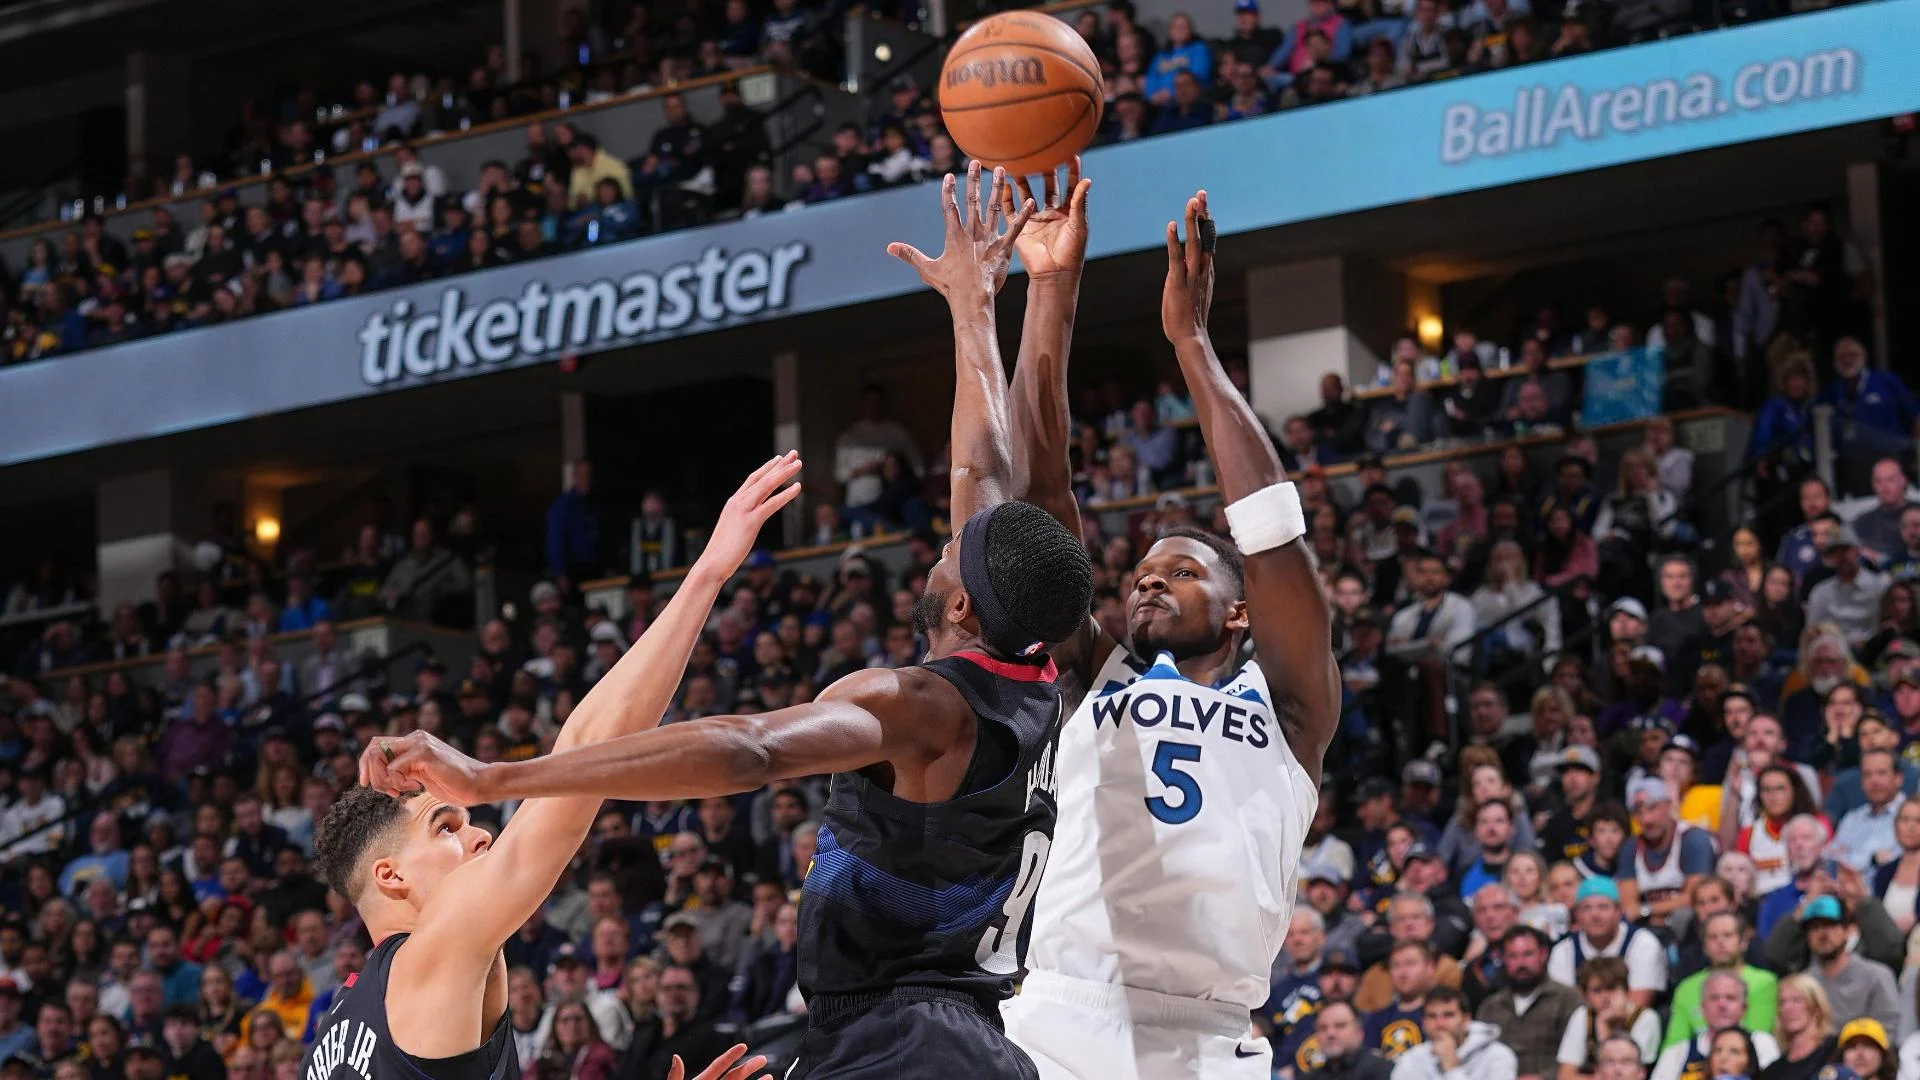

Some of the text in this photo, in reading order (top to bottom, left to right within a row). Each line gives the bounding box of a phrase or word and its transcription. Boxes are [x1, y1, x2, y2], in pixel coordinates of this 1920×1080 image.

[1440, 48, 1859, 164] BallArena.com
[358, 242, 807, 386] ticketmaster
[1092, 692, 1269, 749] WOLVES
[1144, 740, 1203, 825] 5
[975, 830, 1051, 974] 9
[347, 1021, 377, 1080] JR.
